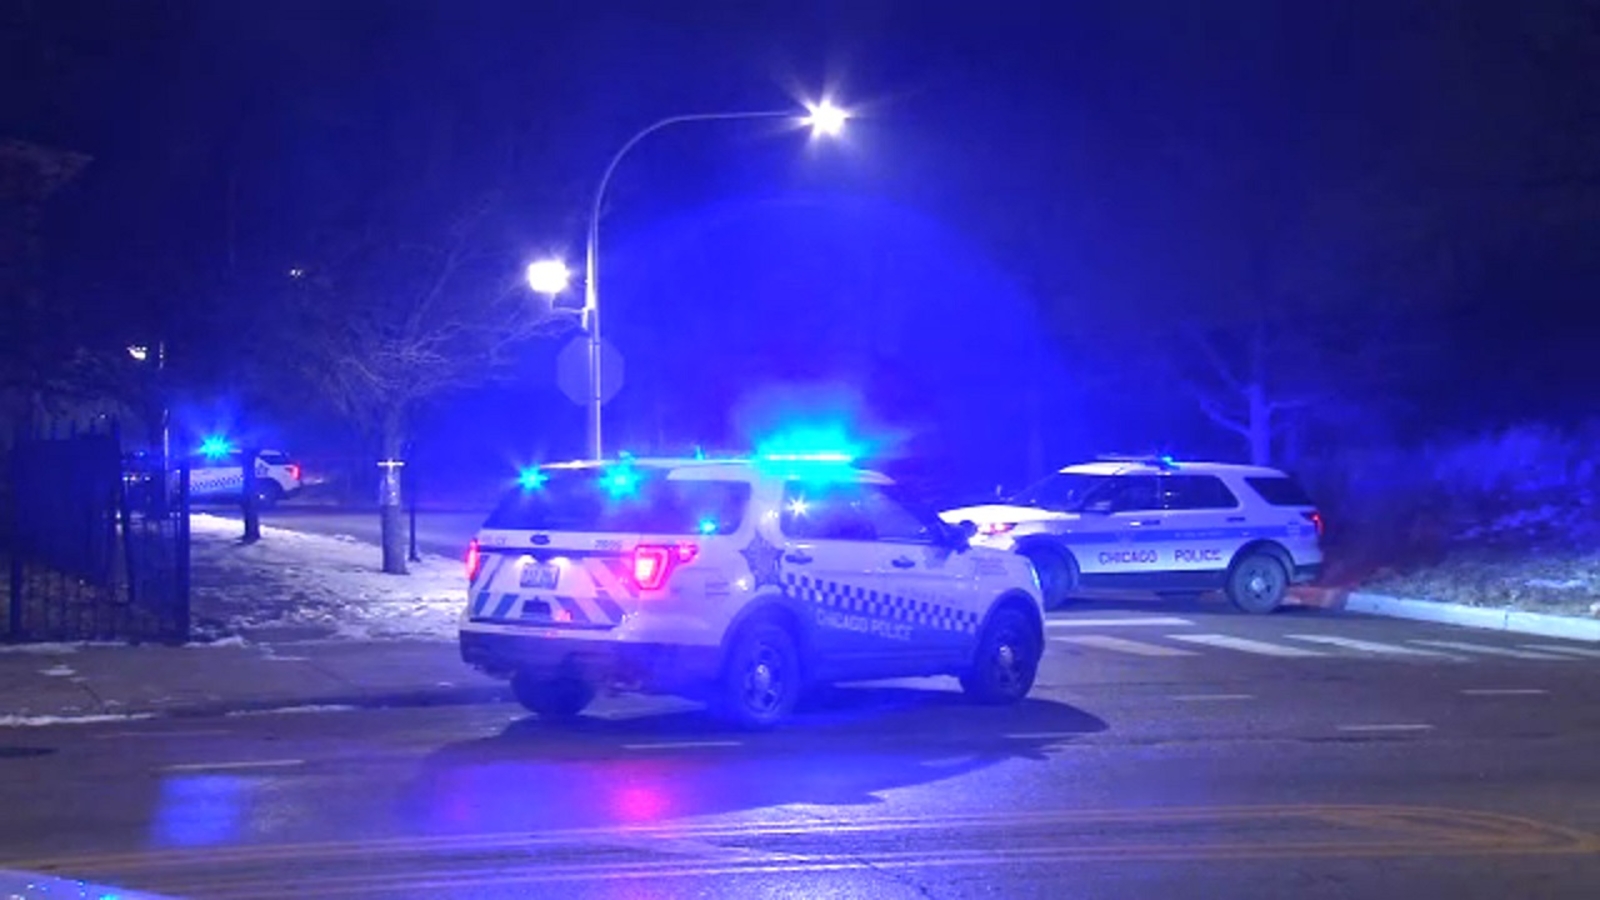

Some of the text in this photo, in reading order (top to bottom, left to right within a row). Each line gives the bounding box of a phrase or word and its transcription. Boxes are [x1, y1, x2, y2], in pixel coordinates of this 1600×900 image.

[1098, 548, 1223, 565] CHICAGO POLICE
[816, 607, 914, 641] CHICAGO POLICE
